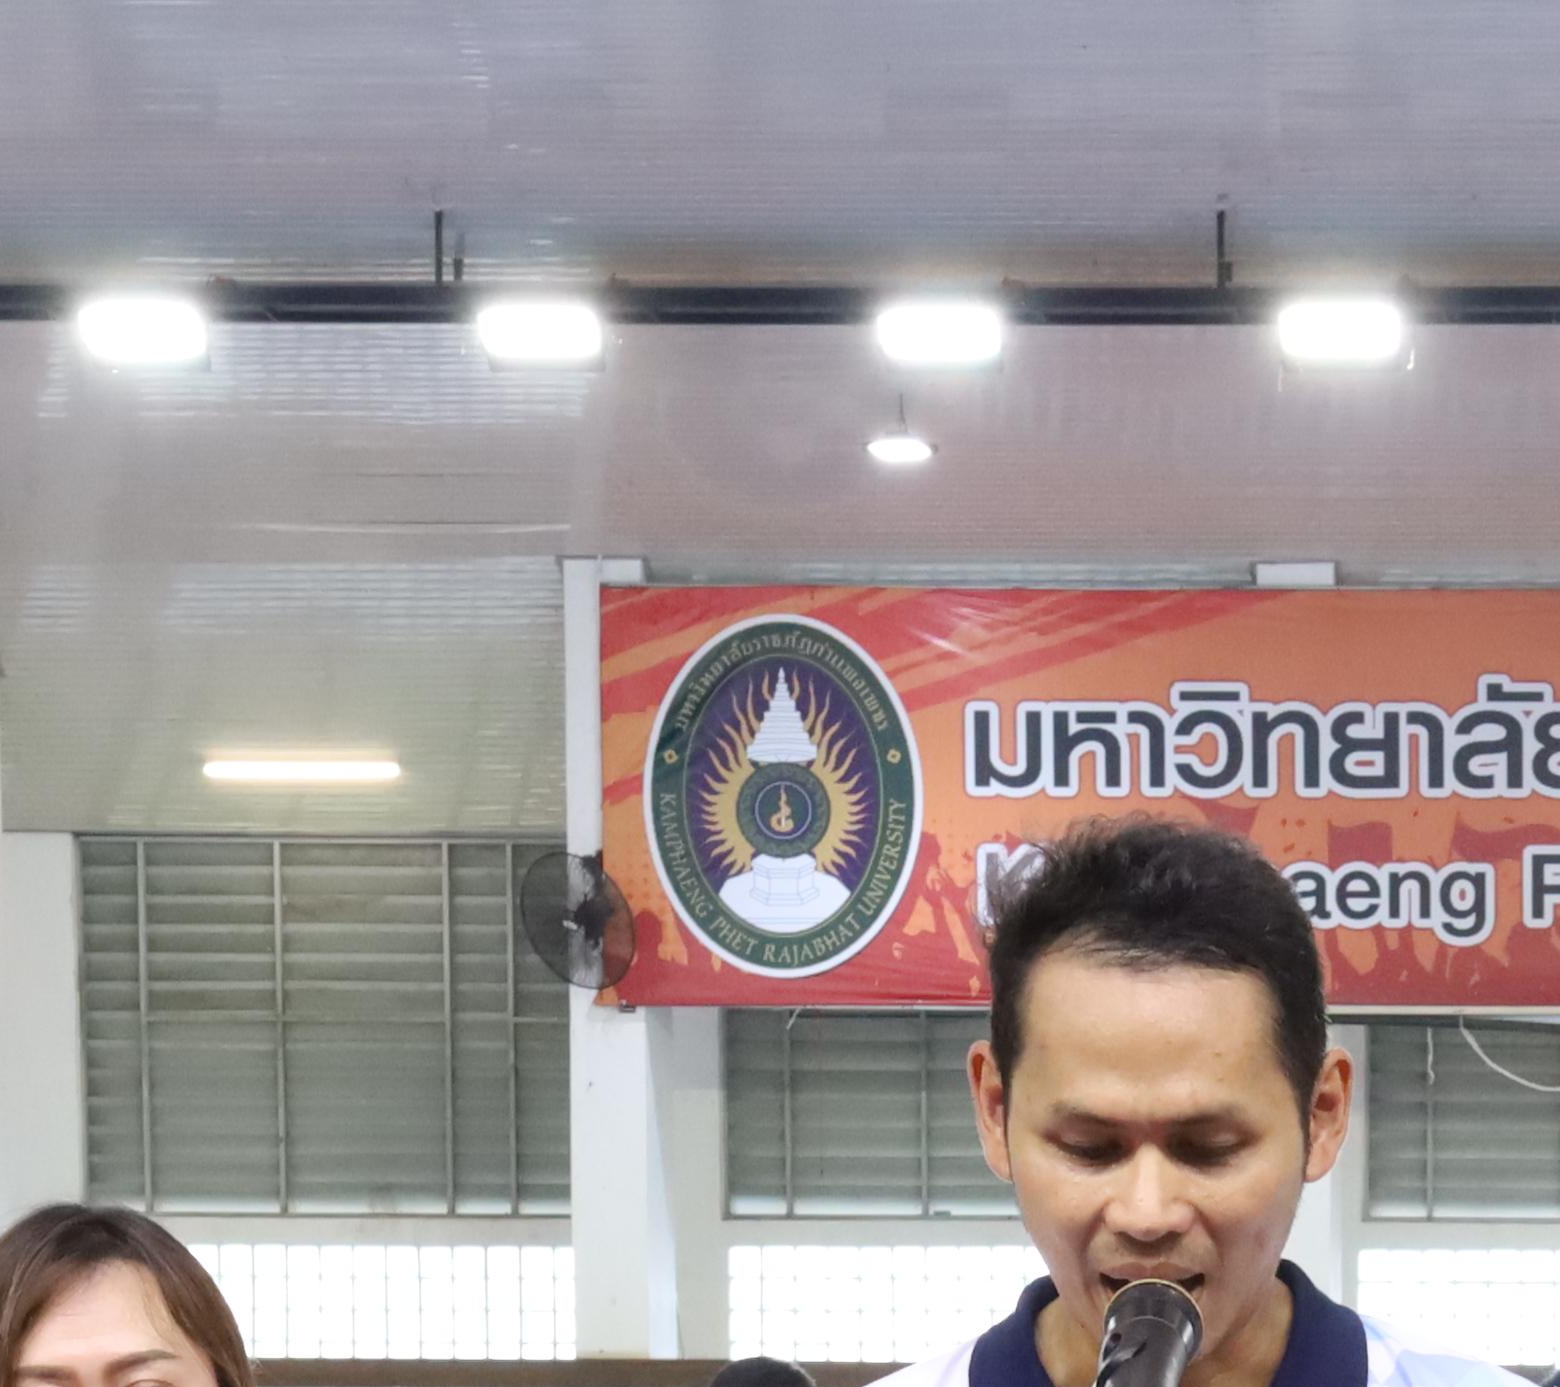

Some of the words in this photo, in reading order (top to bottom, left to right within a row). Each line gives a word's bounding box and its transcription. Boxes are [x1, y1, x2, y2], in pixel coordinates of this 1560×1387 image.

[659, 793, 708, 918] KAMPHAENG
[709, 918, 757, 956] PHET
[763, 917, 861, 966] RAJABHAT
[861, 799, 907, 918] UNIVERSITY
[985, 851, 1486, 936] Kaeng
